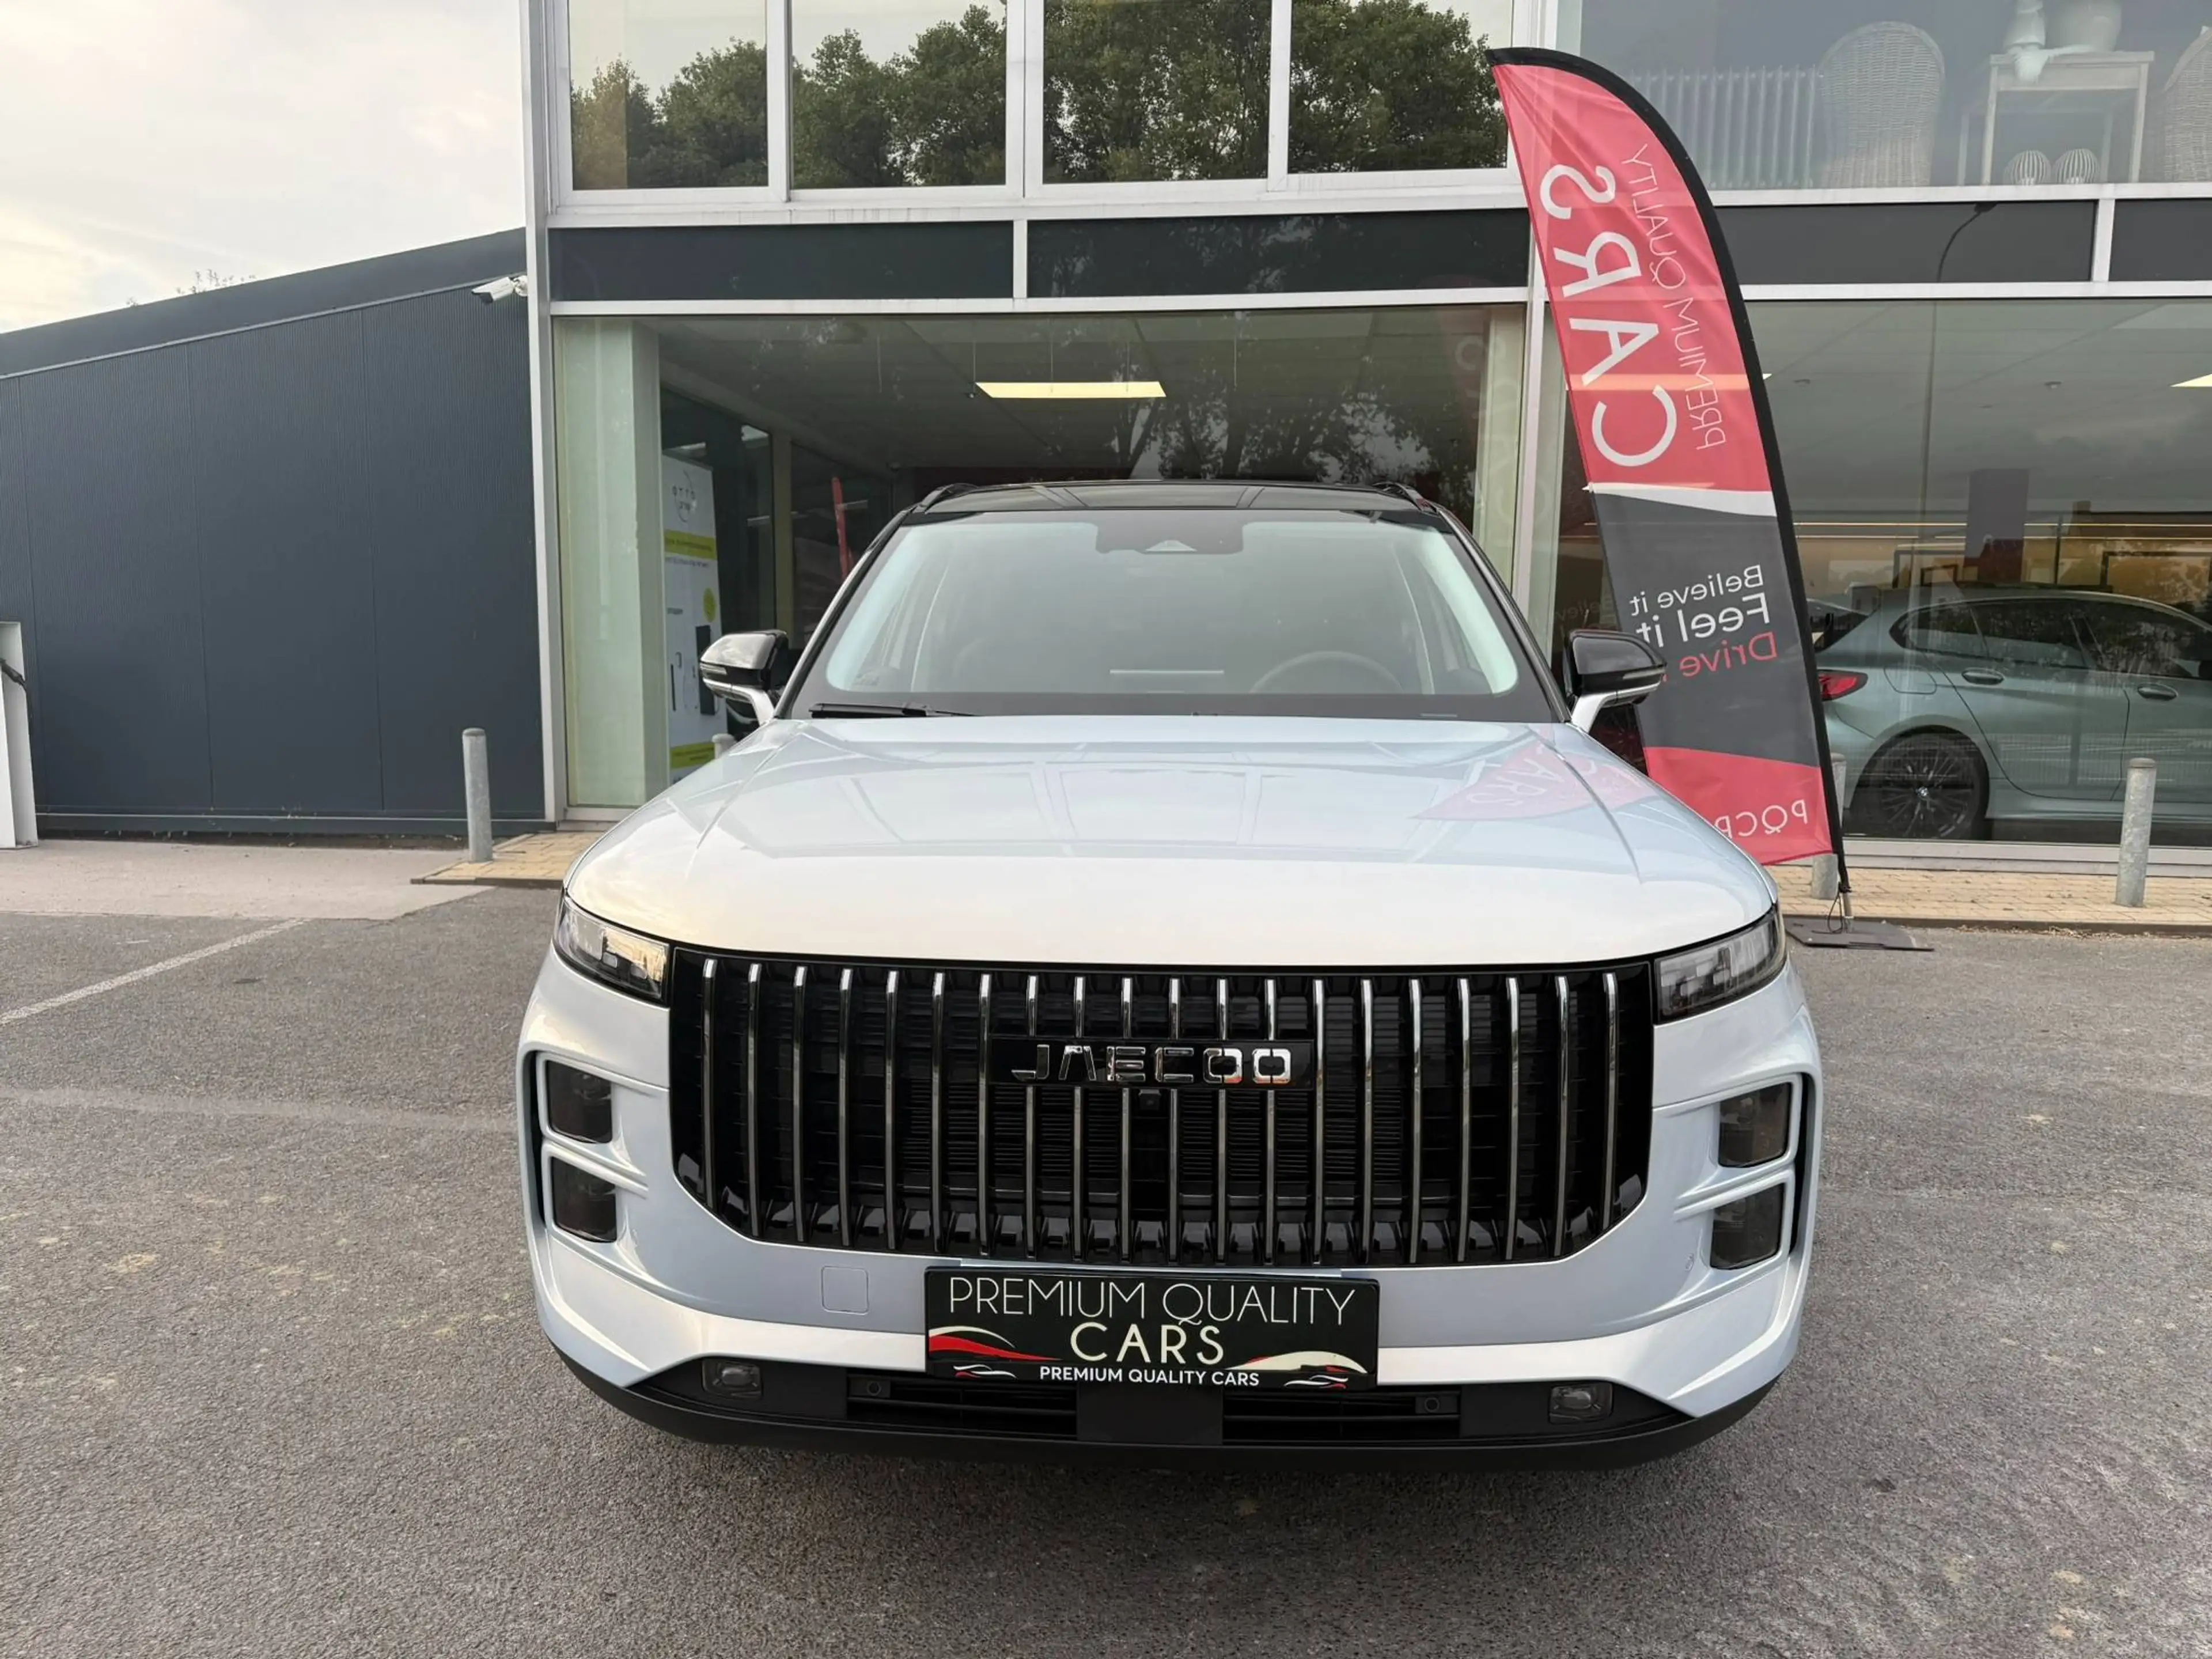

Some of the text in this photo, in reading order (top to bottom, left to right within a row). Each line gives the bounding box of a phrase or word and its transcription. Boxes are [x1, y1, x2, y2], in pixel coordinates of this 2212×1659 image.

[1011, 1044, 1291, 1084] JAECOO
[949, 1277, 1355, 1325] PREMIUM QUALITY
[1070, 1322, 1225, 1365] CARS
[1039, 1366, 1259, 1387] PREMIUM QUALITY CARS
